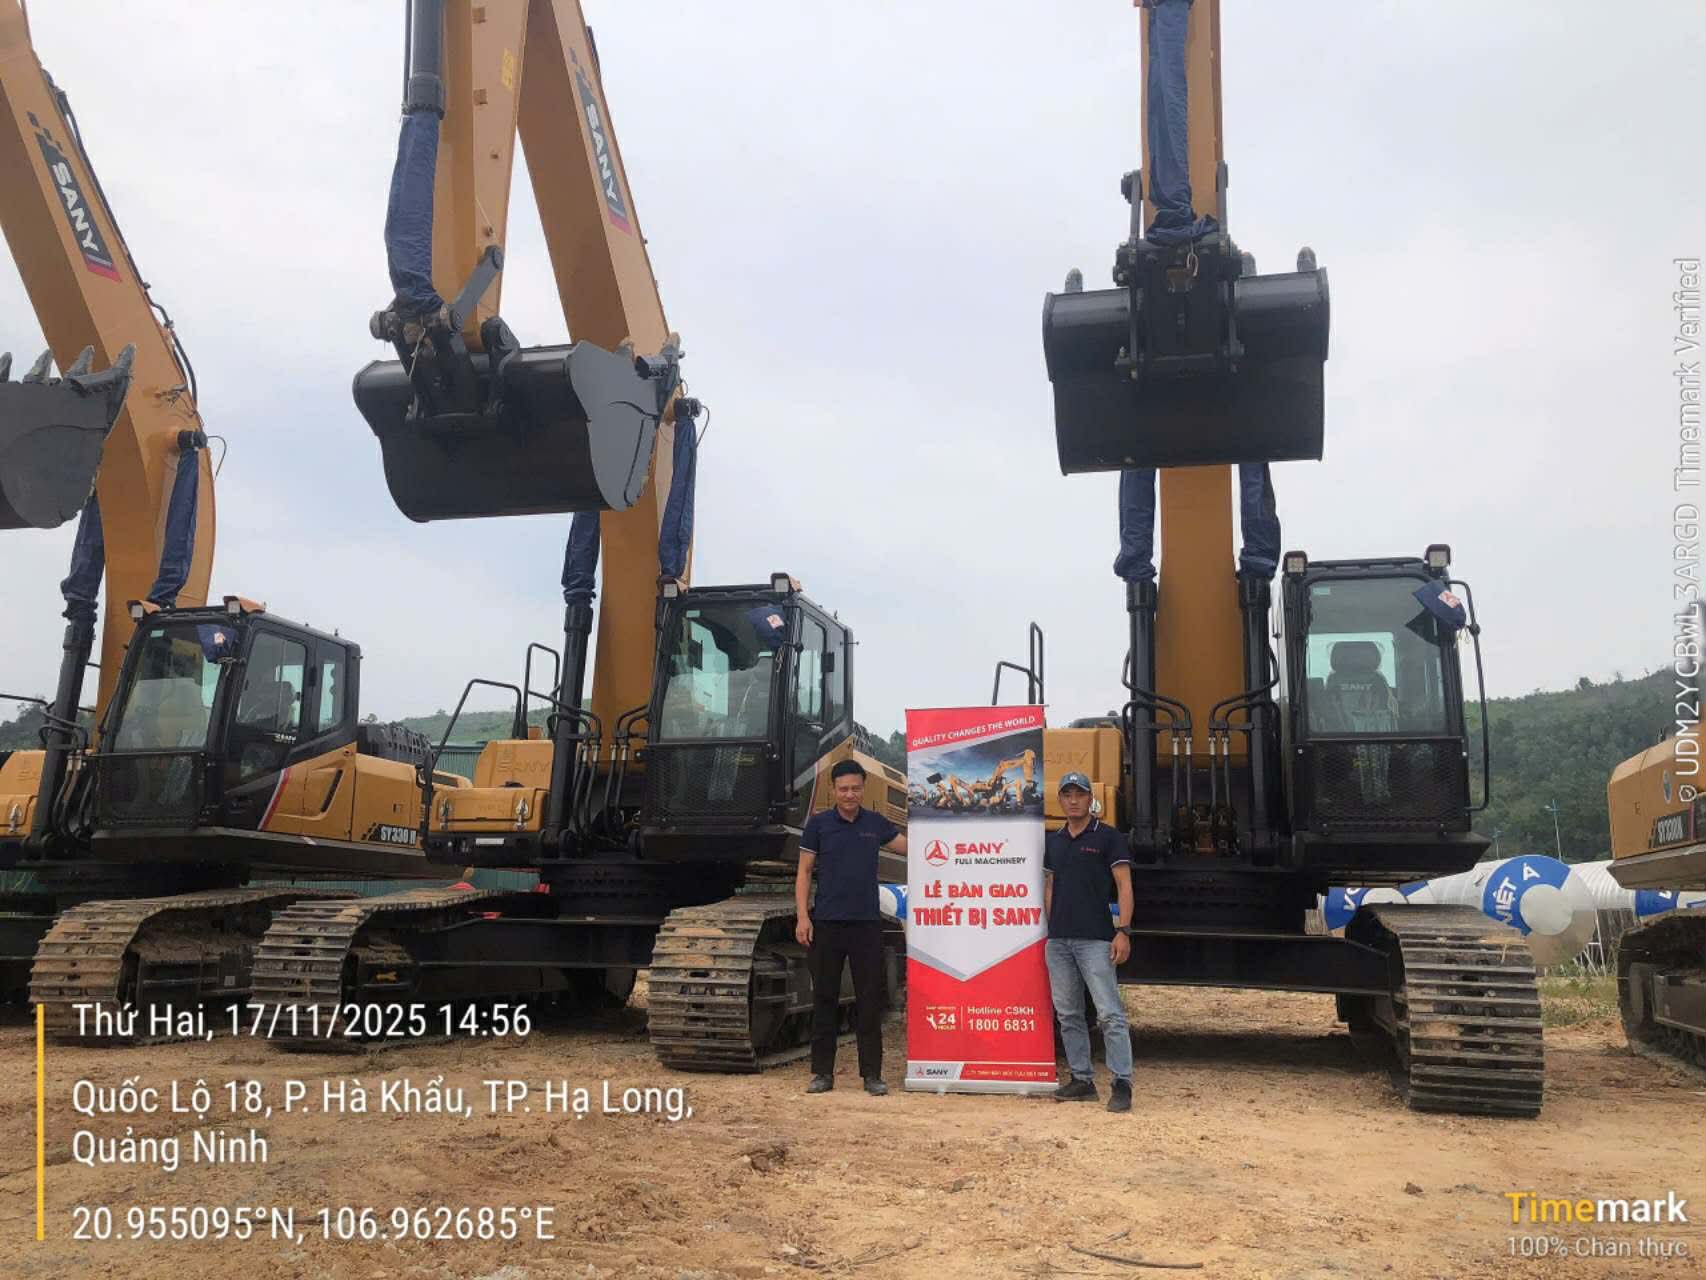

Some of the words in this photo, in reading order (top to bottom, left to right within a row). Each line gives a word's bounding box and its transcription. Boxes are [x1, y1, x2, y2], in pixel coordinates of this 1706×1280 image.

[585, 103, 618, 202] SANY
[52, 161, 100, 252] SANY
[912, 733, 946, 747] QUALITY
[947, 725, 986, 739] CHANGES
[988, 721, 1003, 732] THE
[1005, 715, 1036, 728] WORLD
[954, 842, 1004, 855] SANY
[975, 857, 1026, 865] MACHINERY
[948, 881, 983, 898] BÀN
[988, 883, 1029, 898] GIAO
[913, 902, 963, 926] THIẾT
[968, 908, 987, 930] BỊ
[992, 907, 1041, 926] SANY
[967, 1006, 1002, 1015] Hotline
[1004, 1006, 1034, 1015] CSKH
[938, 1013, 956, 1025] 24
[967, 1018, 999, 1031] 1800
[1004, 1019, 1035, 1032] 6831
